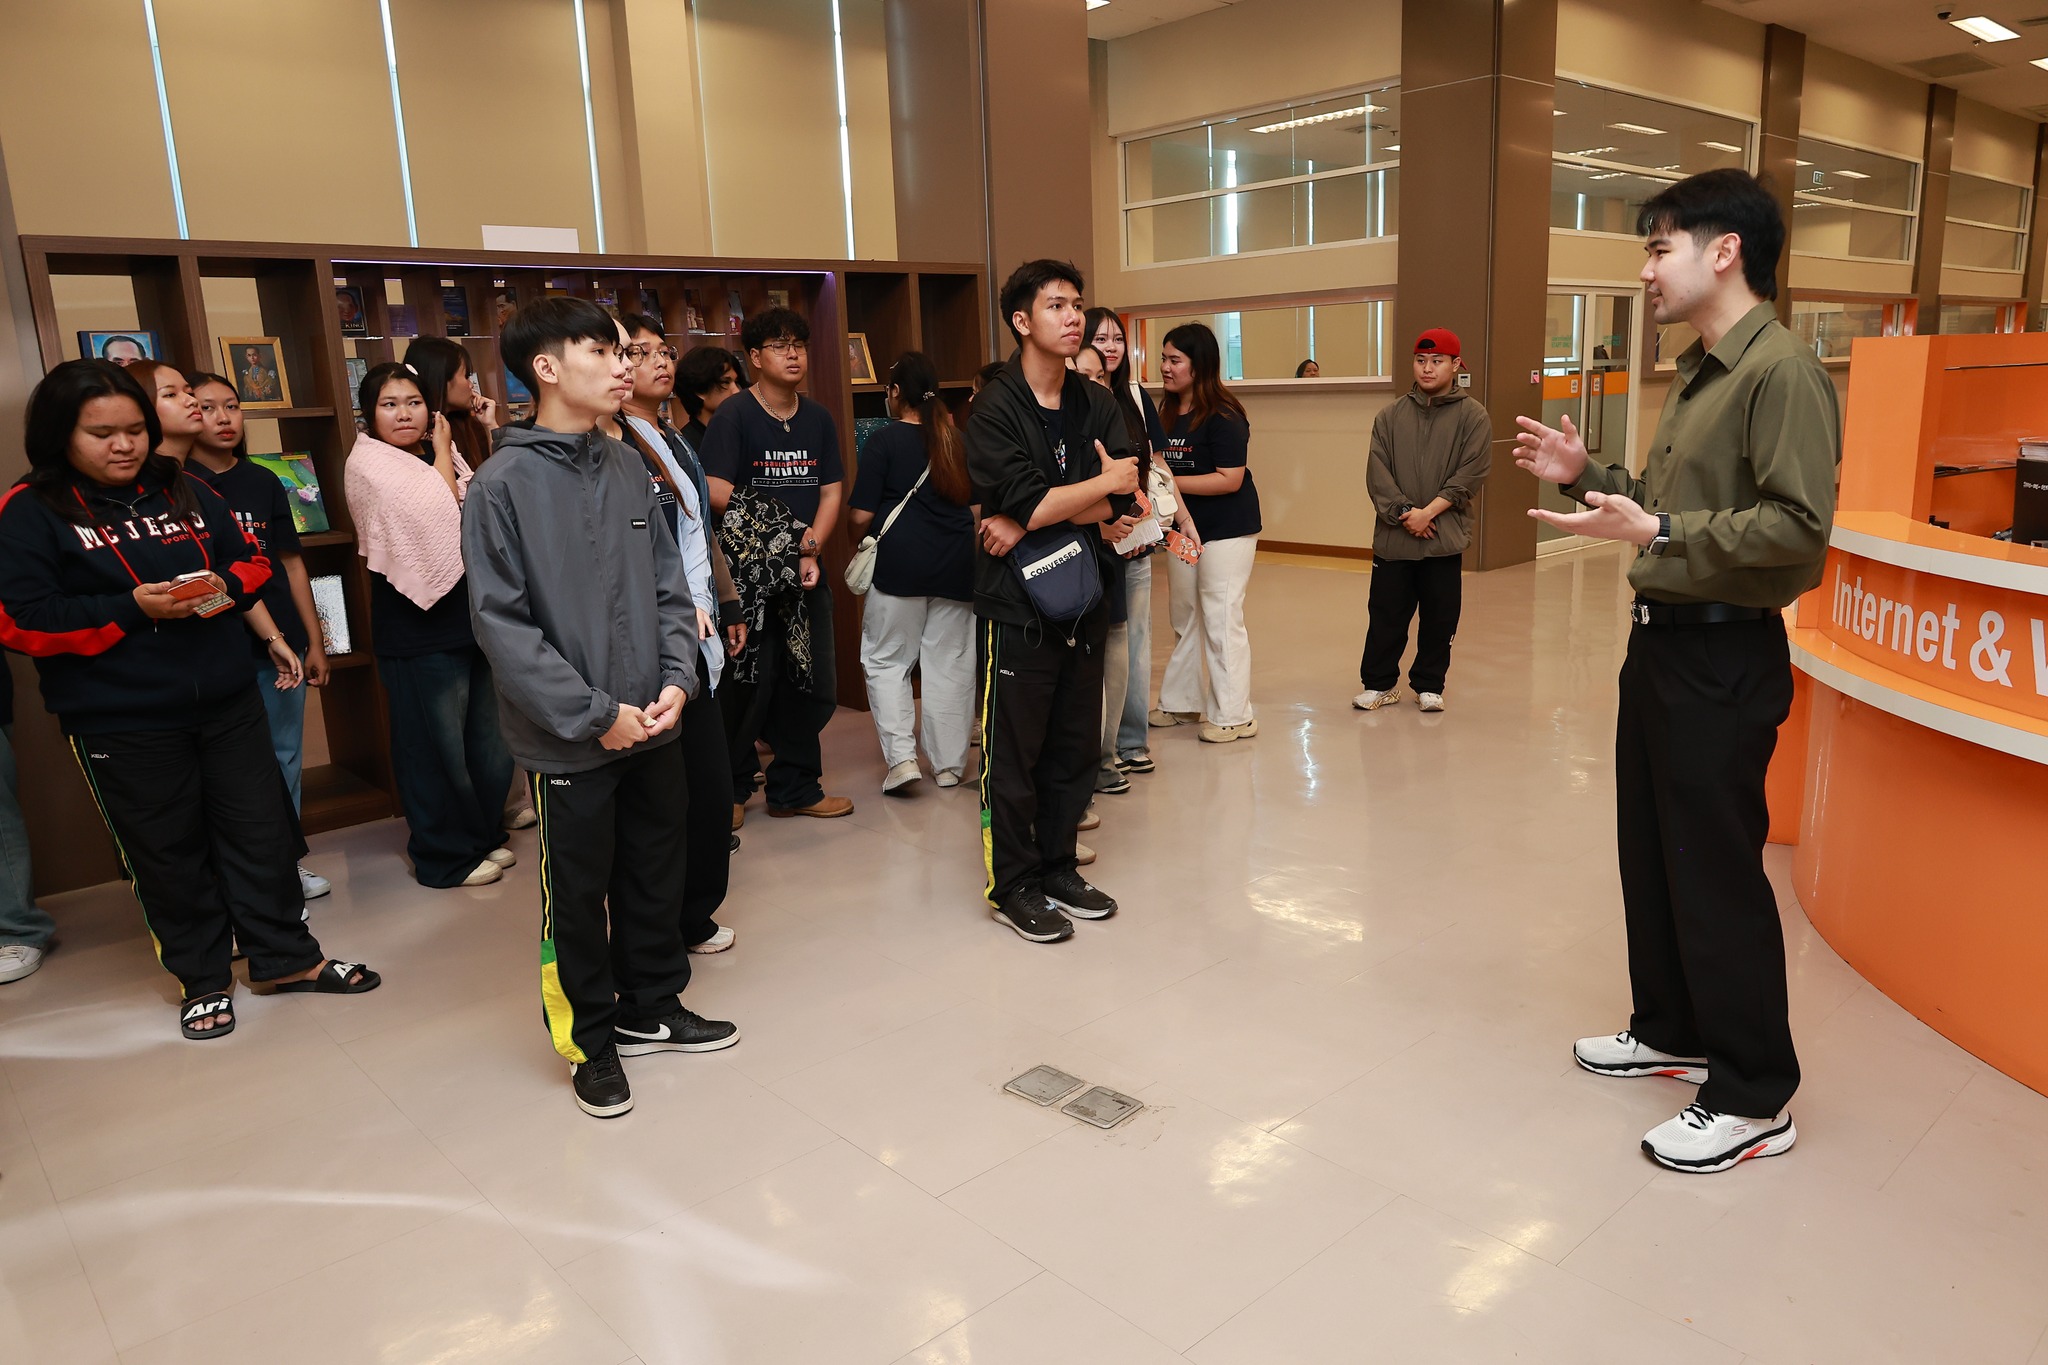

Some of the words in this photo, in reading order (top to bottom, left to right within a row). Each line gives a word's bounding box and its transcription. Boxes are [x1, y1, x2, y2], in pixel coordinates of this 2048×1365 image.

[123, 511, 207, 541] JEAS
[1030, 551, 1073, 577] CONVERSE
[1832, 563, 1961, 671] Internet
[1969, 610, 2014, 688] &
[550, 778, 572, 786] KELA
[182, 998, 231, 1022] Ari
